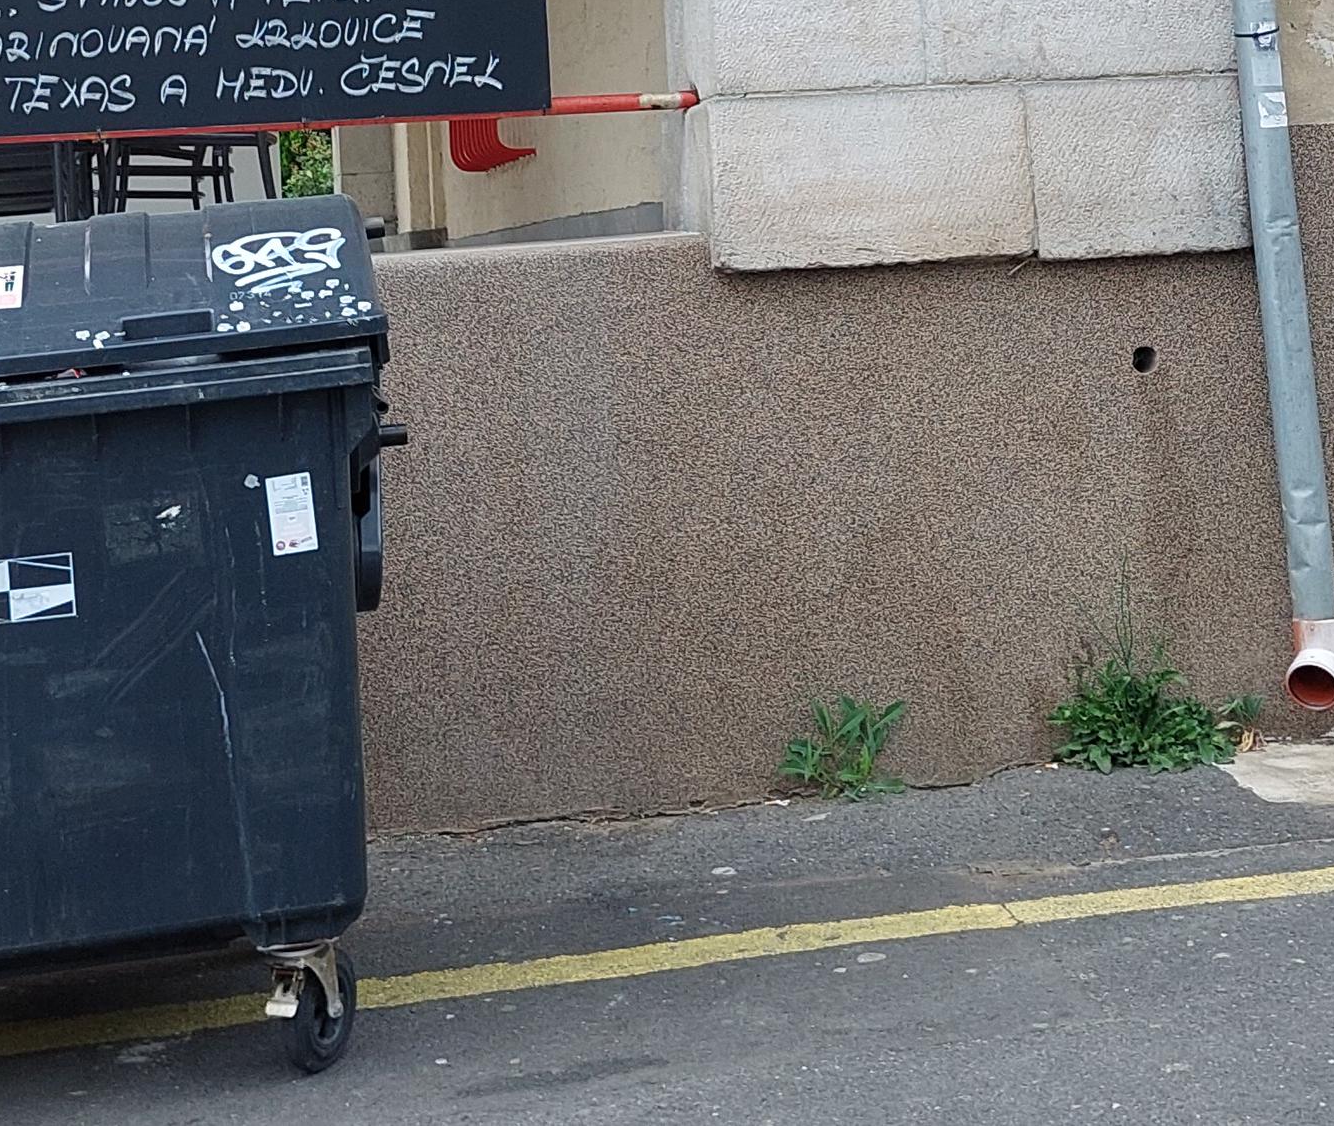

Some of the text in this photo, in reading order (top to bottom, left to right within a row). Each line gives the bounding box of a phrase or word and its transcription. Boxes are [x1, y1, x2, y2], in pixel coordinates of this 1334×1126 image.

[235, 8, 436, 49] KRKOVICE
[4, 73, 136, 114] TEXAS
[160, 74, 187, 107] A
[340, 49, 503, 97] ČESNEK
